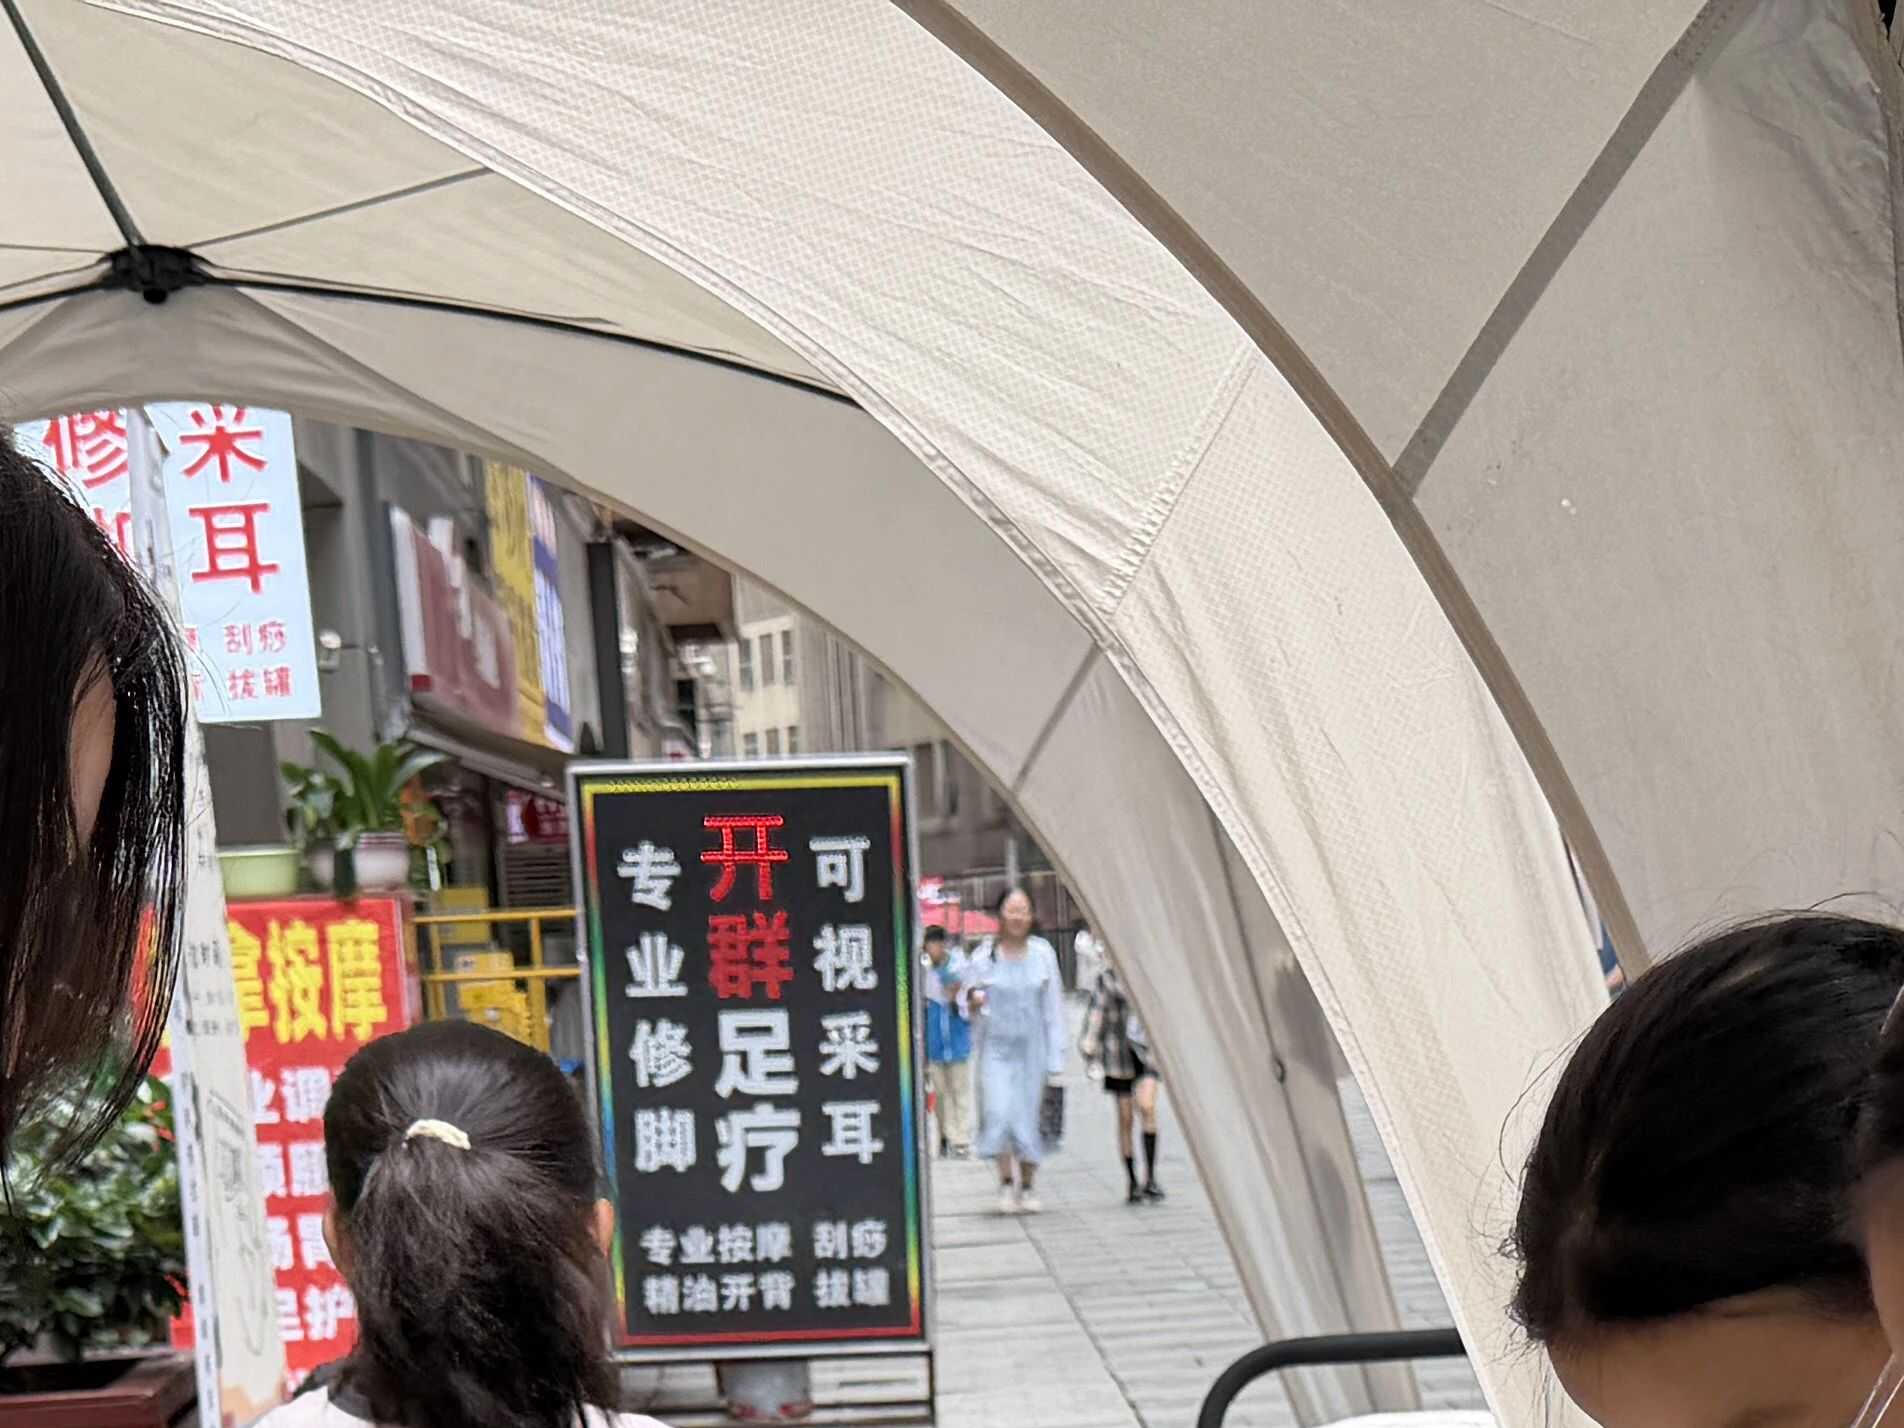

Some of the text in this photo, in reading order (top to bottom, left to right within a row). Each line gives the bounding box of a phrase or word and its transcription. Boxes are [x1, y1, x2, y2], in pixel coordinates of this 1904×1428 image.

[224, 623, 288, 655] 刮痧
[228, 667, 292, 700] 拔罐
[616, 839, 697, 1173] 专业修脚
[700, 814, 801, 1193] 开群足疗
[809, 834, 884, 1166] 可视采耳
[640, 1219, 889, 1265] 专业按摩 刮痧
[643, 1268, 891, 1315] 精油开背 拔罐
